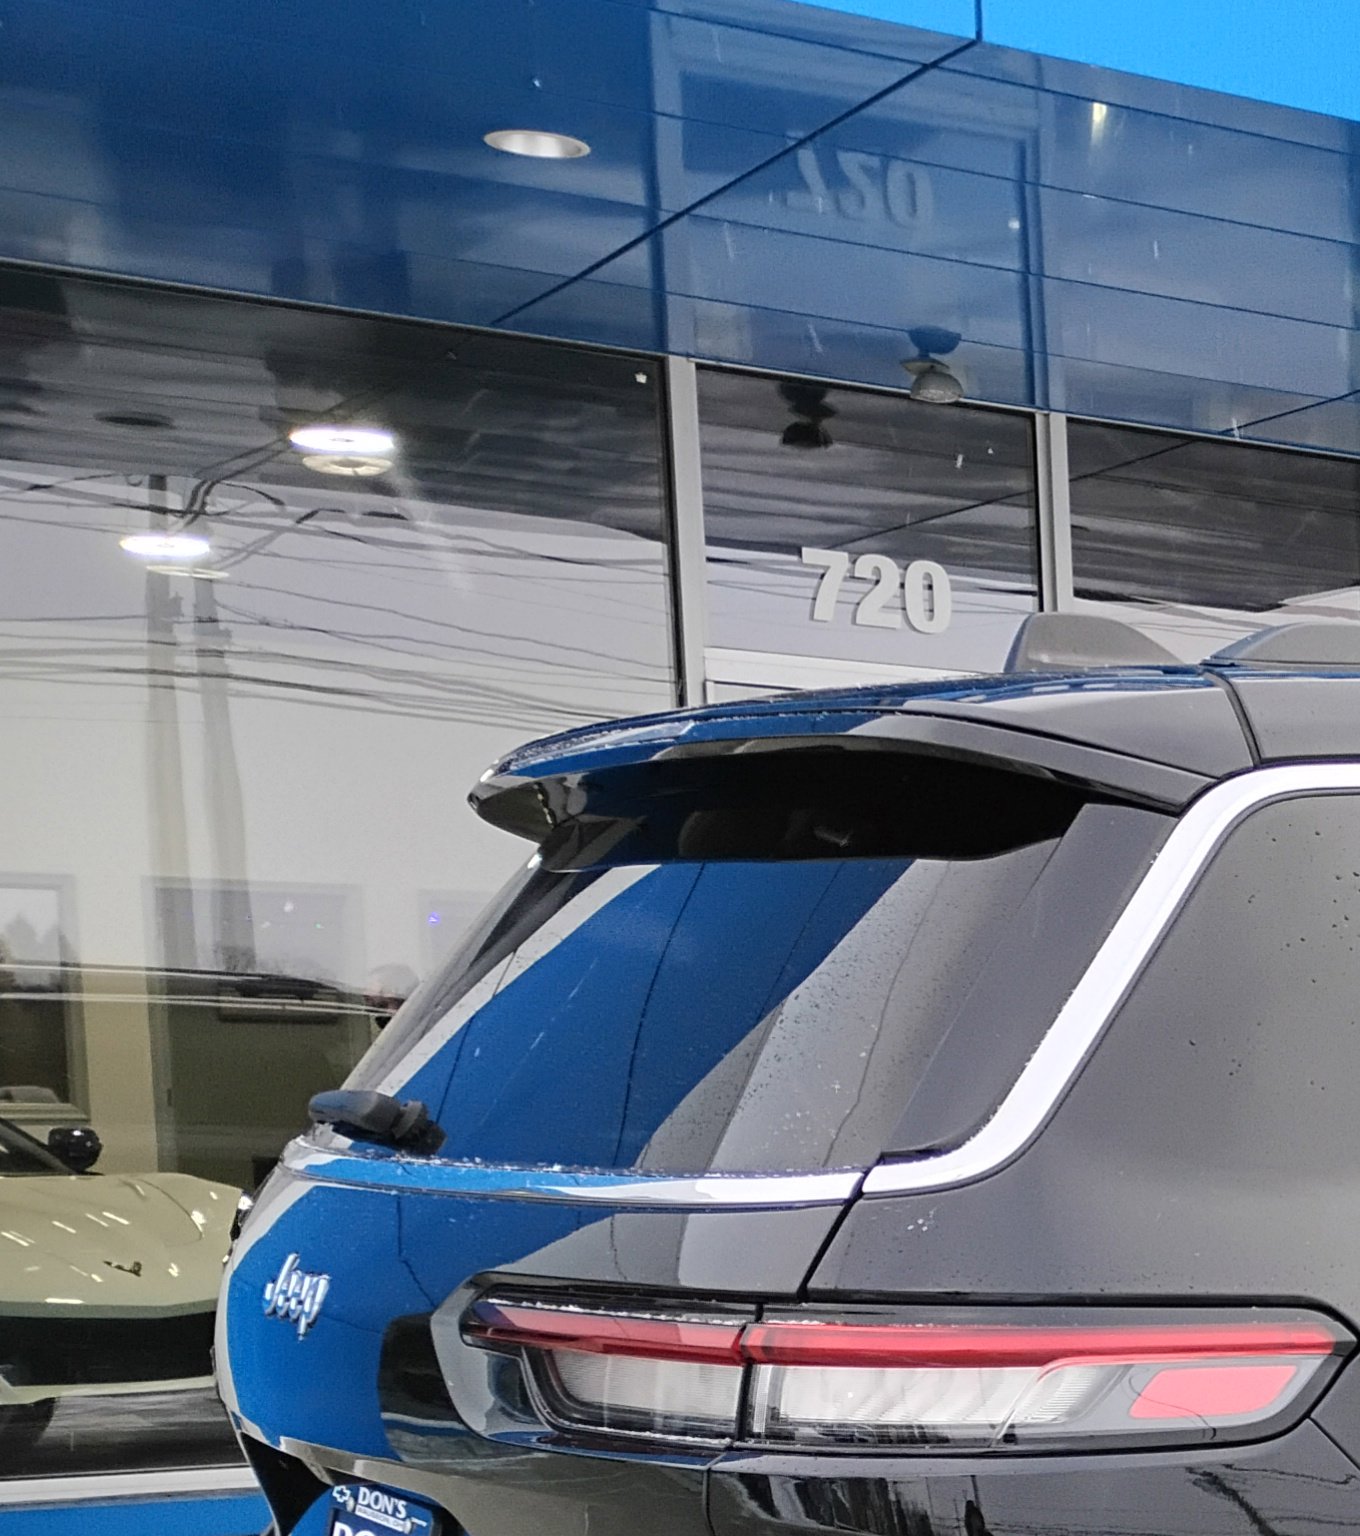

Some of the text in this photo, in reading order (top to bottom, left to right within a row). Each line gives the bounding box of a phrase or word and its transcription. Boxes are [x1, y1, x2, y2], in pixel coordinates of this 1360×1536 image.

[801, 547, 952, 634] 720
[262, 1252, 332, 1341] Jeep
[357, 1486, 408, 1519] DON'S
